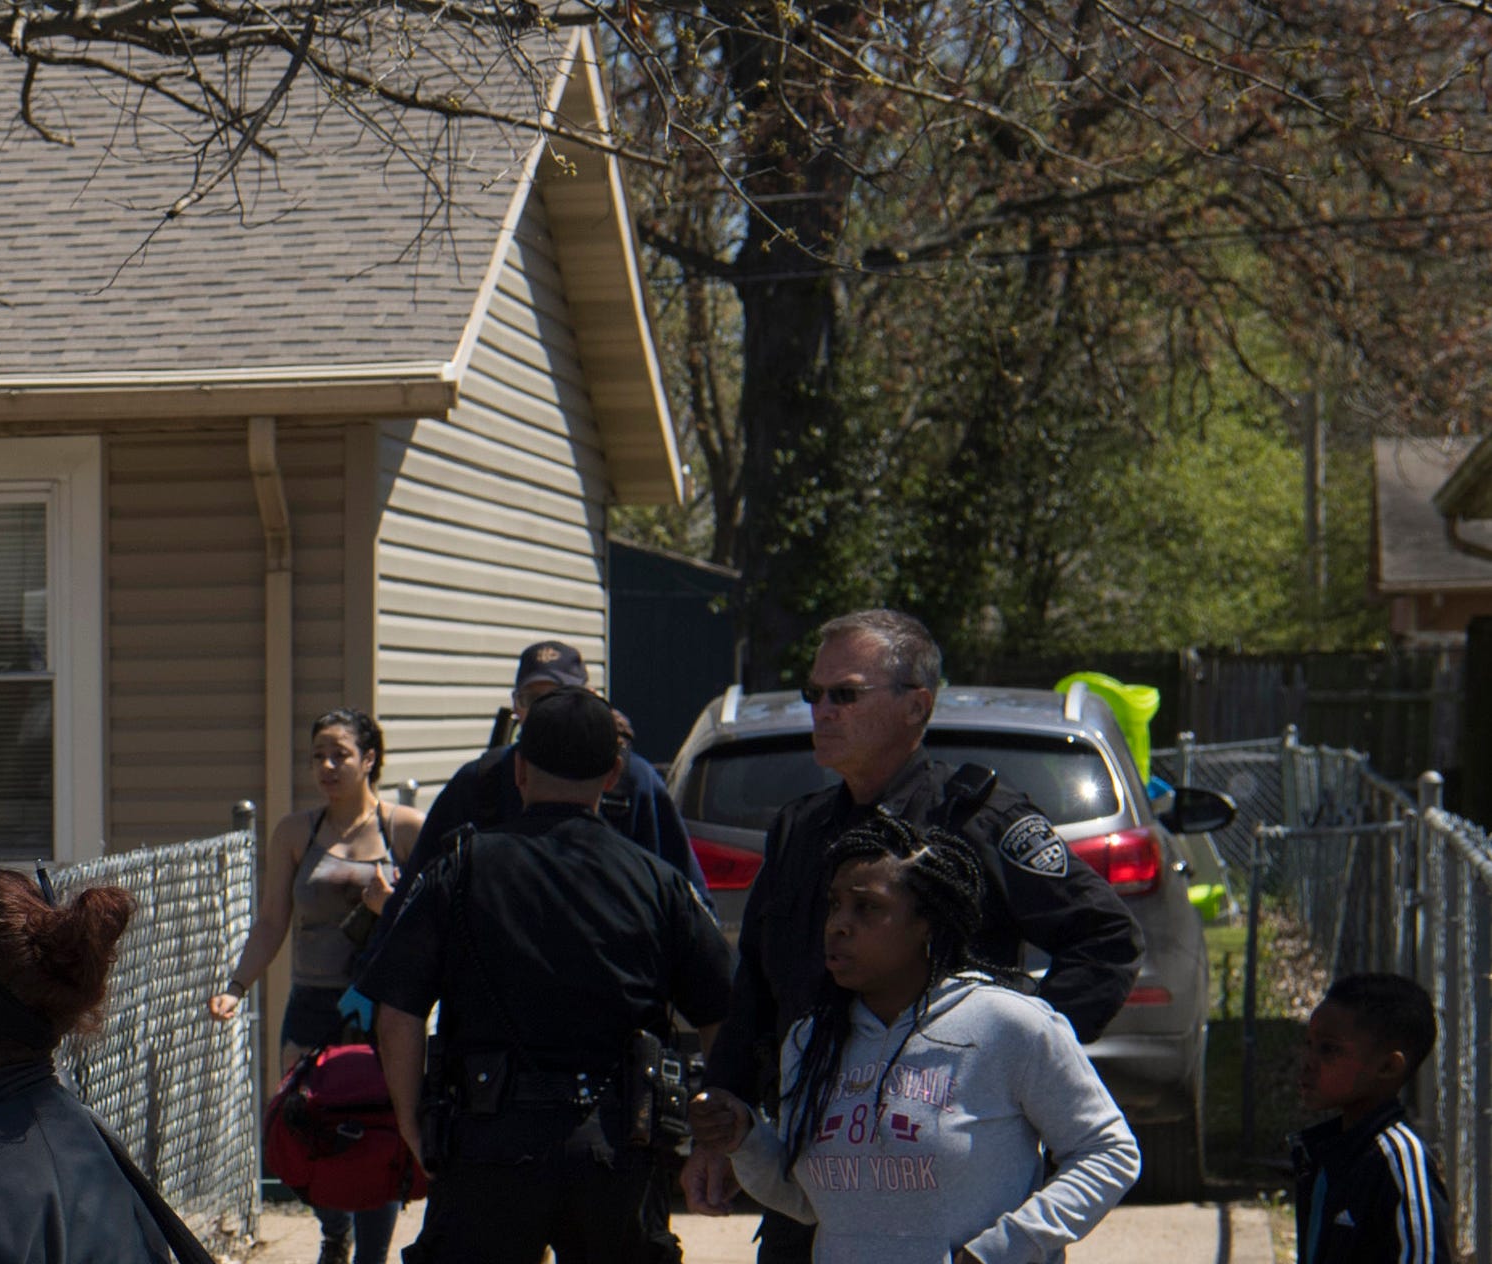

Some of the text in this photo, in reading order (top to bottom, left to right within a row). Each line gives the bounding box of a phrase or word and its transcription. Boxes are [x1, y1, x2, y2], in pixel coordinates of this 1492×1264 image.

[848, 1103, 889, 1145] 87
[806, 1153, 939, 1192] NEW YORK
